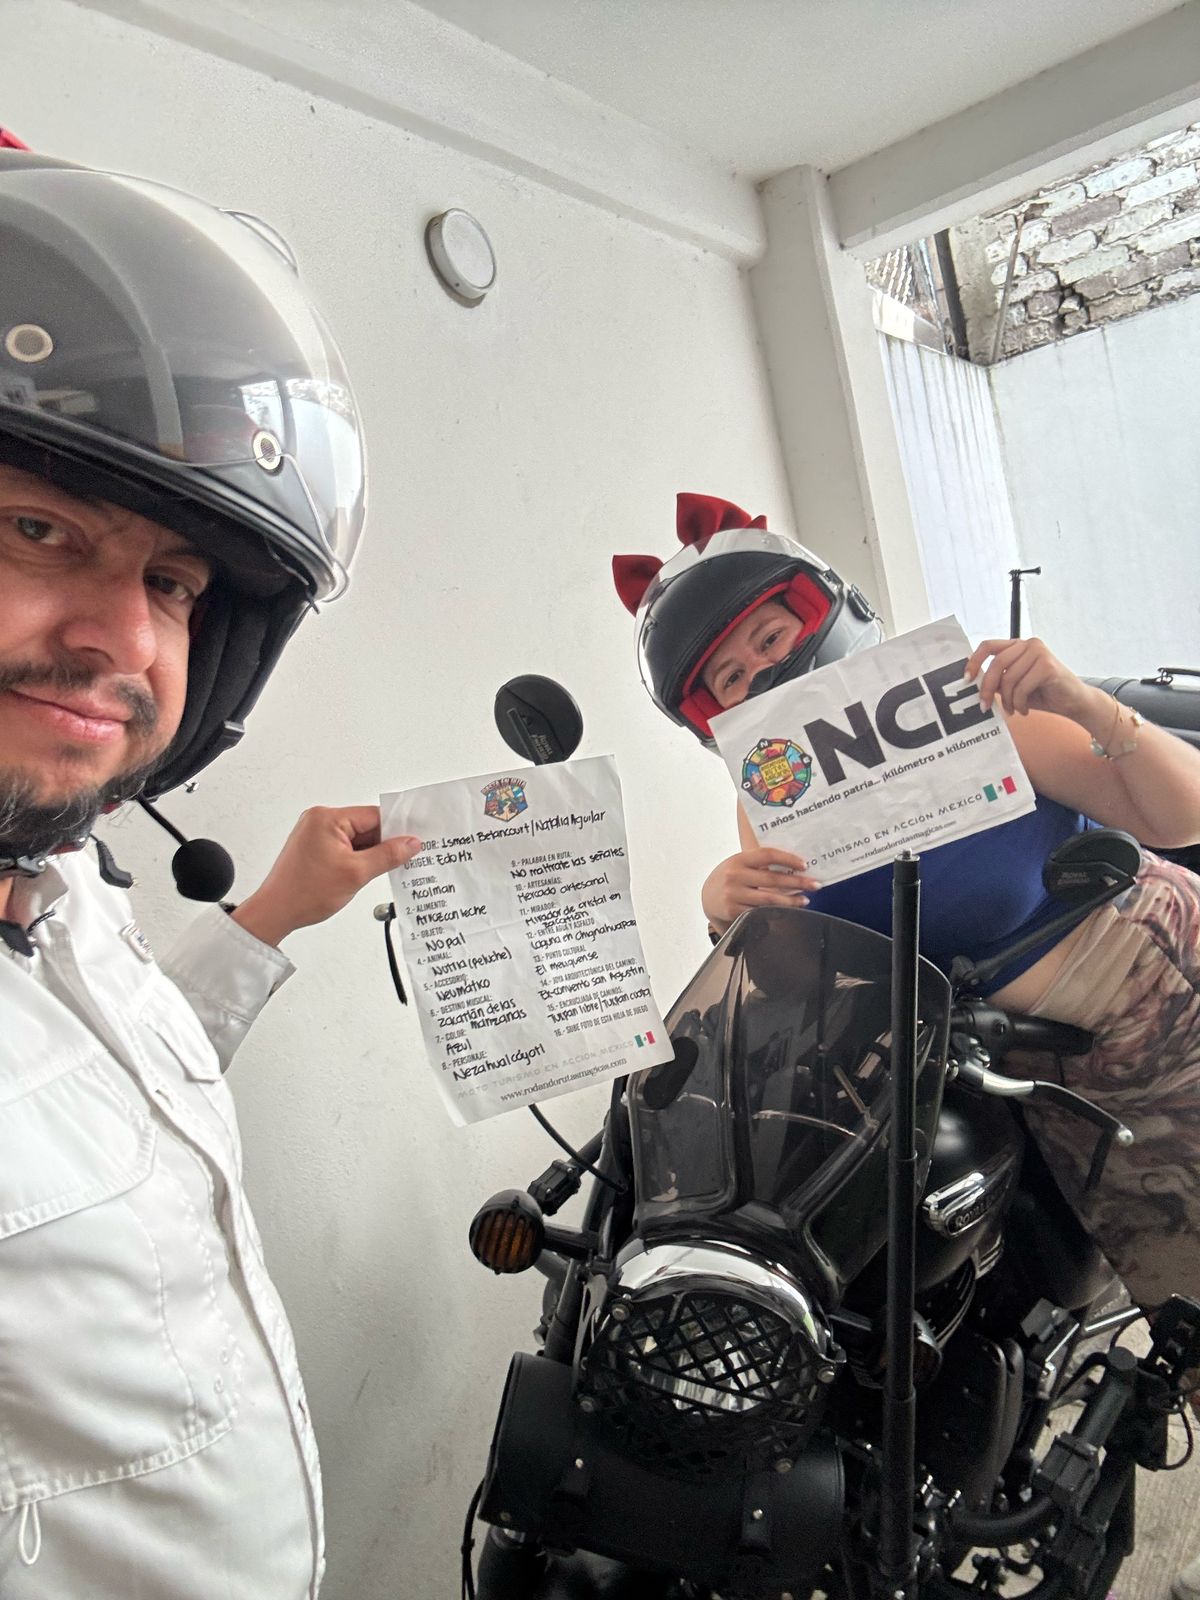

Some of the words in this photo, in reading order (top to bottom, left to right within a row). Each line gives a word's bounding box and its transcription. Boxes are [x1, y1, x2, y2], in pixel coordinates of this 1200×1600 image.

[759, 822, 769, 832] 11
[770, 812, 795, 828] años
[795, 793, 841, 818] haciendo
[937, 750, 945, 758] a
[945, 726, 1001, 755] kilómetro!
[441, 834, 475, 849] Ismael
[821, 837, 871, 861] TURISMO
[874, 828, 890, 840] EN
[521, 854, 547, 866] PALABRA
[548, 853, 556, 861] EN
[571, 856, 586, 867] las
[411, 884, 456, 900] Acolman
[563, 905, 576, 917] de
[535, 964, 547, 976] El
